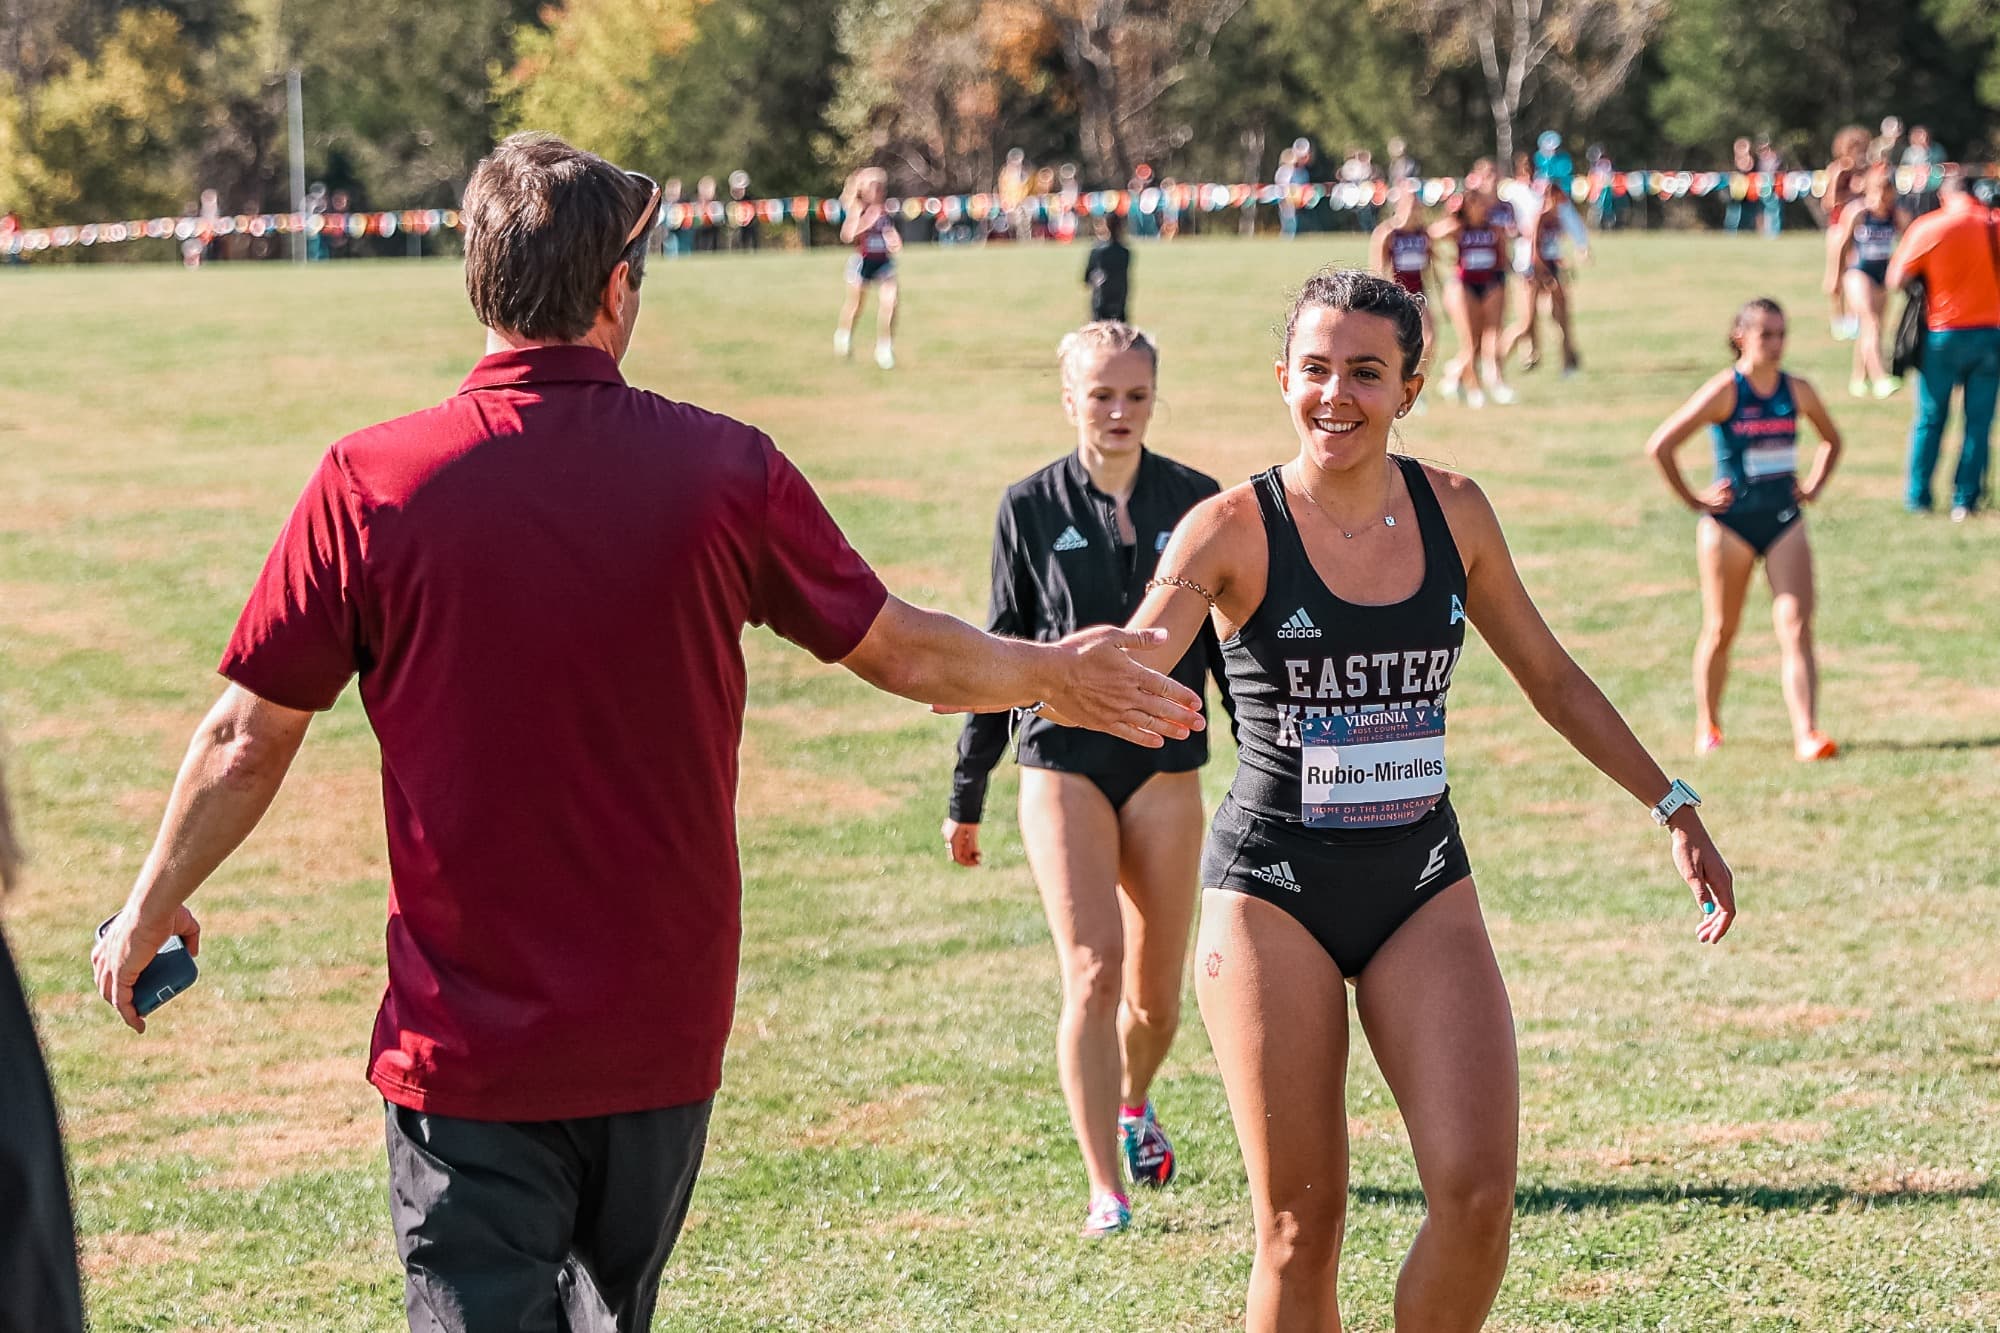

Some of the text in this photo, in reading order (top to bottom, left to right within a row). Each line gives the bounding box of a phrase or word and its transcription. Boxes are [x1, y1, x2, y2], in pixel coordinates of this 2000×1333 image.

[1277, 625, 1322, 639] adidas
[1344, 711, 1408, 728] VIRGINIA
[1347, 724, 1409, 736] CROSS COUNTRY
[1307, 758, 1443, 785] Rubio-Miralles
[1311, 806, 1341, 814] HOME
[1343, 806, 1357, 814] OF
[1359, 805, 1377, 813] THE
[1403, 800, 1425, 809] NCAA
[1343, 811, 1415, 822] CHAMPIONSHIPS
[1250, 868, 1303, 894] adidas
